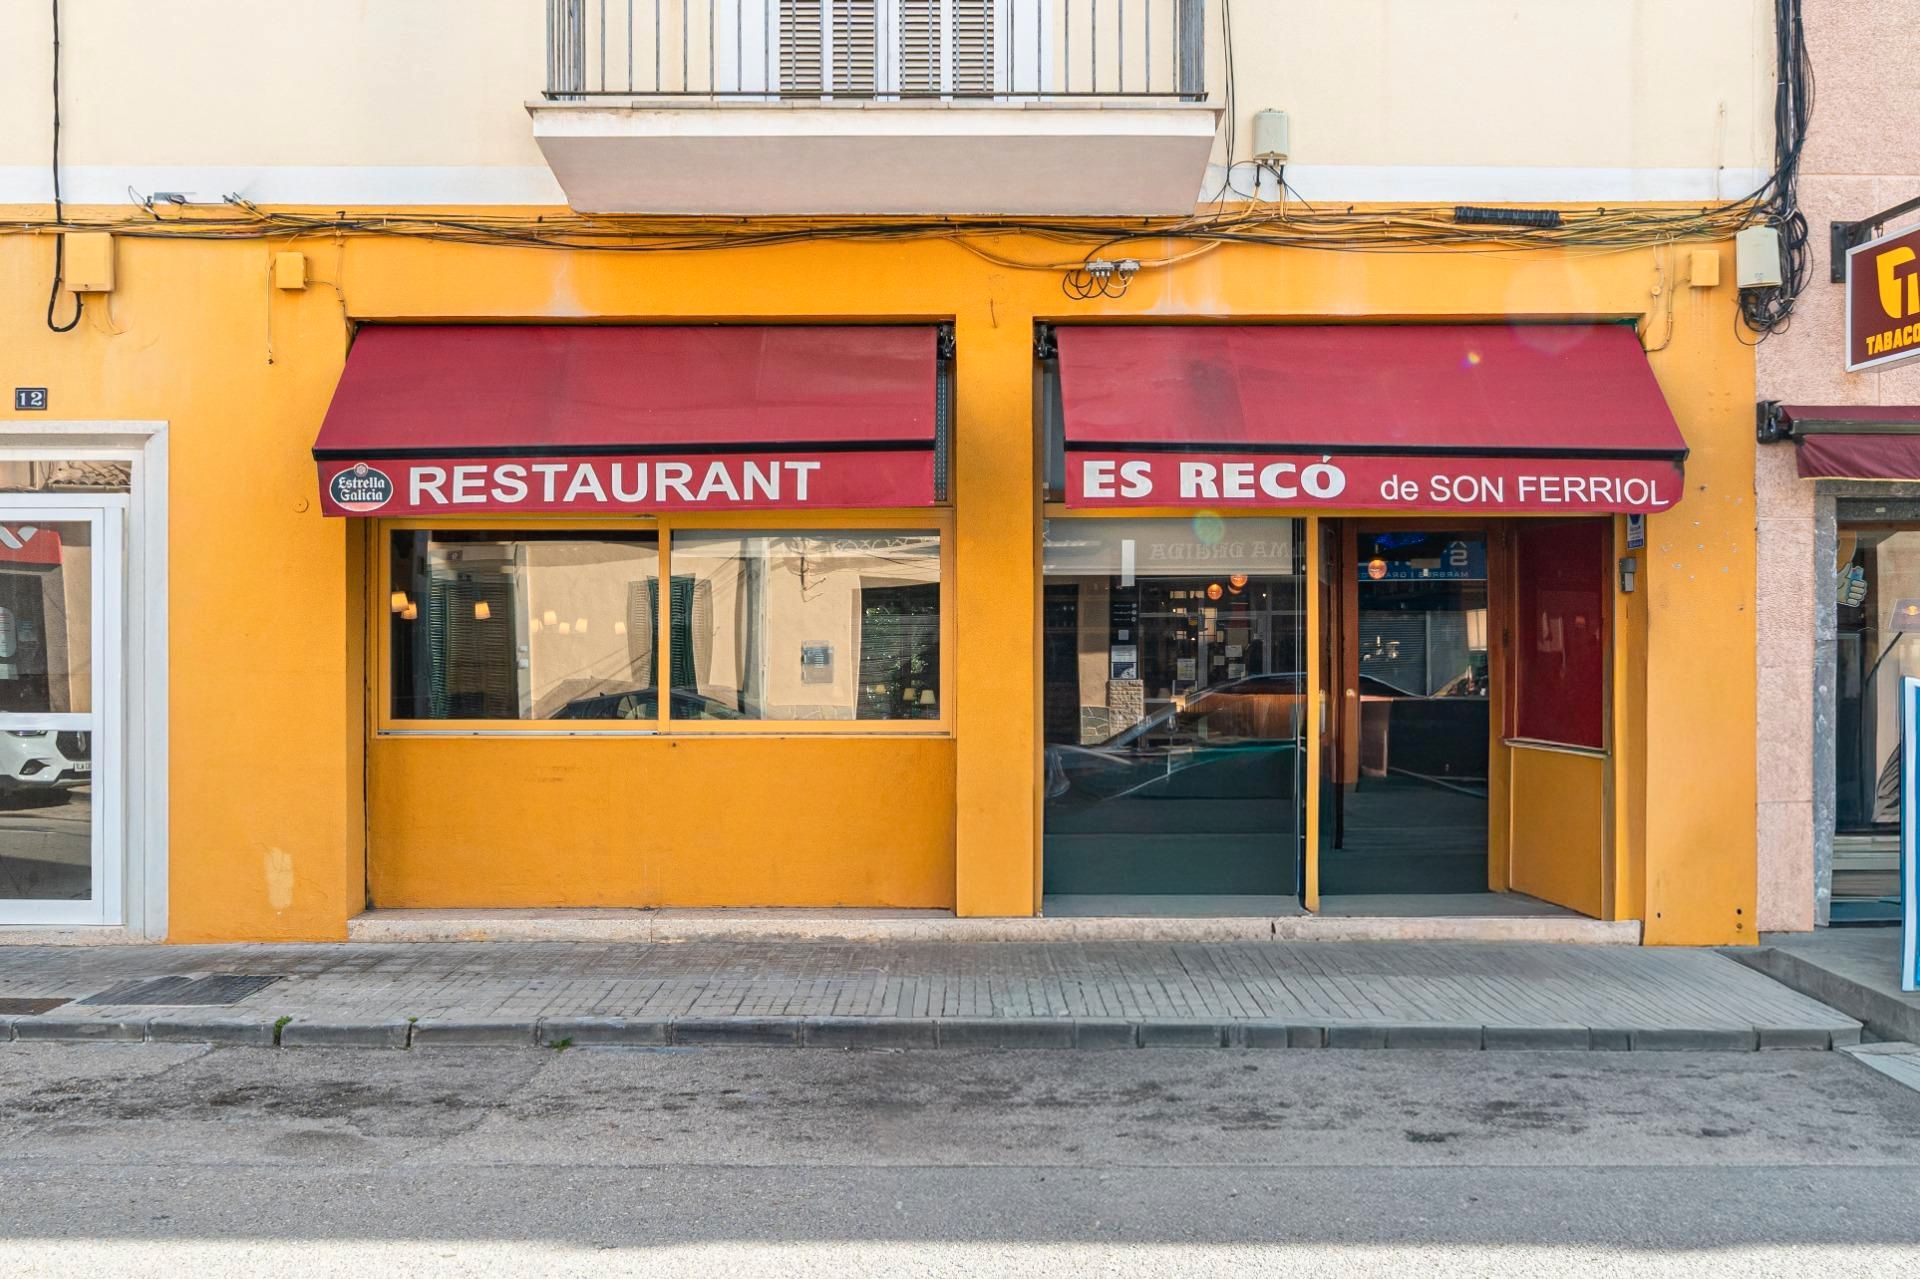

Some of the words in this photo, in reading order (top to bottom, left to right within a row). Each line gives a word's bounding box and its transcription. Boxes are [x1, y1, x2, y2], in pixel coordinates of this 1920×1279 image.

[20, 393, 42, 406] 12
[338, 477, 385, 488] Estrella
[409, 461, 821, 506] RESTAURANT
[1083, 461, 1153, 499] ES
[1179, 455, 1346, 499] RECÓ
[1380, 474, 1419, 501] de
[1430, 475, 1504, 503] SON
[1518, 475, 1669, 507] FERRIOL
[340, 489, 383, 501] Galicia
